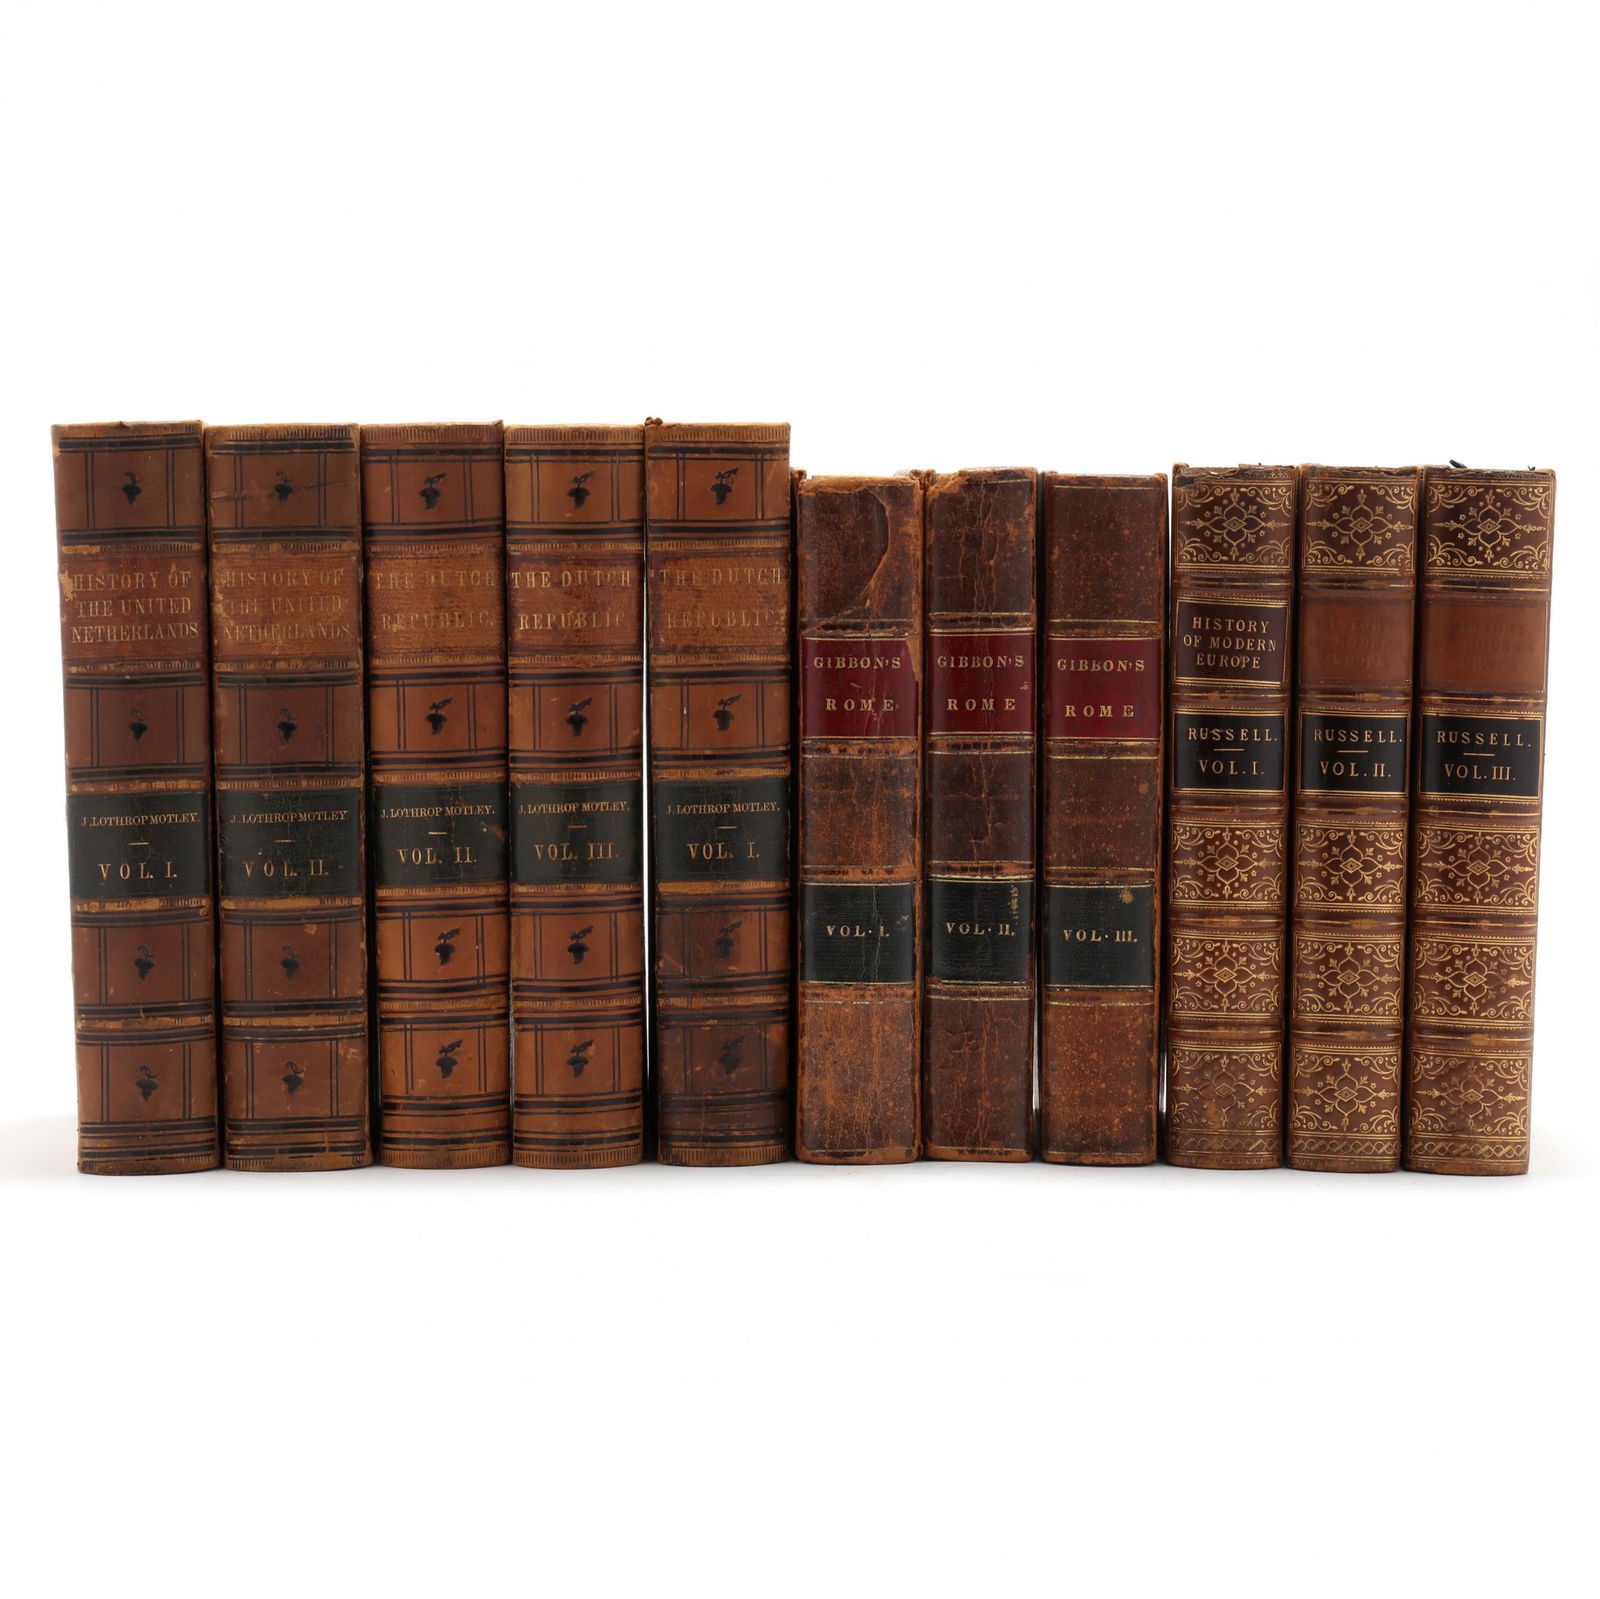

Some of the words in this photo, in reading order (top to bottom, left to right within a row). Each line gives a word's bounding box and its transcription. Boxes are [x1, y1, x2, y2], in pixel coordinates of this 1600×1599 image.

[73, 571, 159, 591] HISTORY
[168, 569, 191, 588] OF
[511, 571, 551, 588] THE
[562, 570, 632, 587] DUTCH
[78, 599, 113, 618] THE
[120, 597, 191, 616] UNITED
[70, 622, 200, 643] NETHERLANDS
[1192, 616, 1270, 633] HISTORY
[1183, 635, 1202, 648] OF
[1209, 637, 1278, 651] MODERN
[813, 655, 901, 670] GIBBON'S
[937, 655, 1025, 669] GIBBON'S
[1057, 658, 1146, 673] GIBBON'S
[1196, 653, 1262, 669] EUROPE
[825, 698, 894, 712] ROME
[946, 698, 1016, 712] ROME
[1064, 704, 1135, 718] ROME
[1188, 727, 1278, 742] RUSSELL.
[1313, 728, 1403, 743] RUSSELL.
[1437, 730, 1532, 747] RUSSELL.
[1199, 760, 1246, 775] VOL.
[1251, 761, 1265, 776] I.
[1320, 762, 1367, 778] VOL.
[1372, 763, 1392, 778] II.
[1444, 764, 1488, 780] VOL.
[1490, 766, 1517, 782] III.
[732, 801, 781, 813] MOTLEY.
[397, 847, 443, 865] VOL.
[454, 846, 478, 864] II.
[533, 842, 578, 861] VOL.
[587, 842, 619, 860] III.
[686, 842, 734, 860] VOL.
[747, 841, 760, 859] I.
[98, 862, 154, 880] VOL.
[164, 861, 178, 878] I.
[242, 860, 298, 878] VOL.
[309, 859, 330, 877] II.
[1114, 929, 1138, 943] III.
